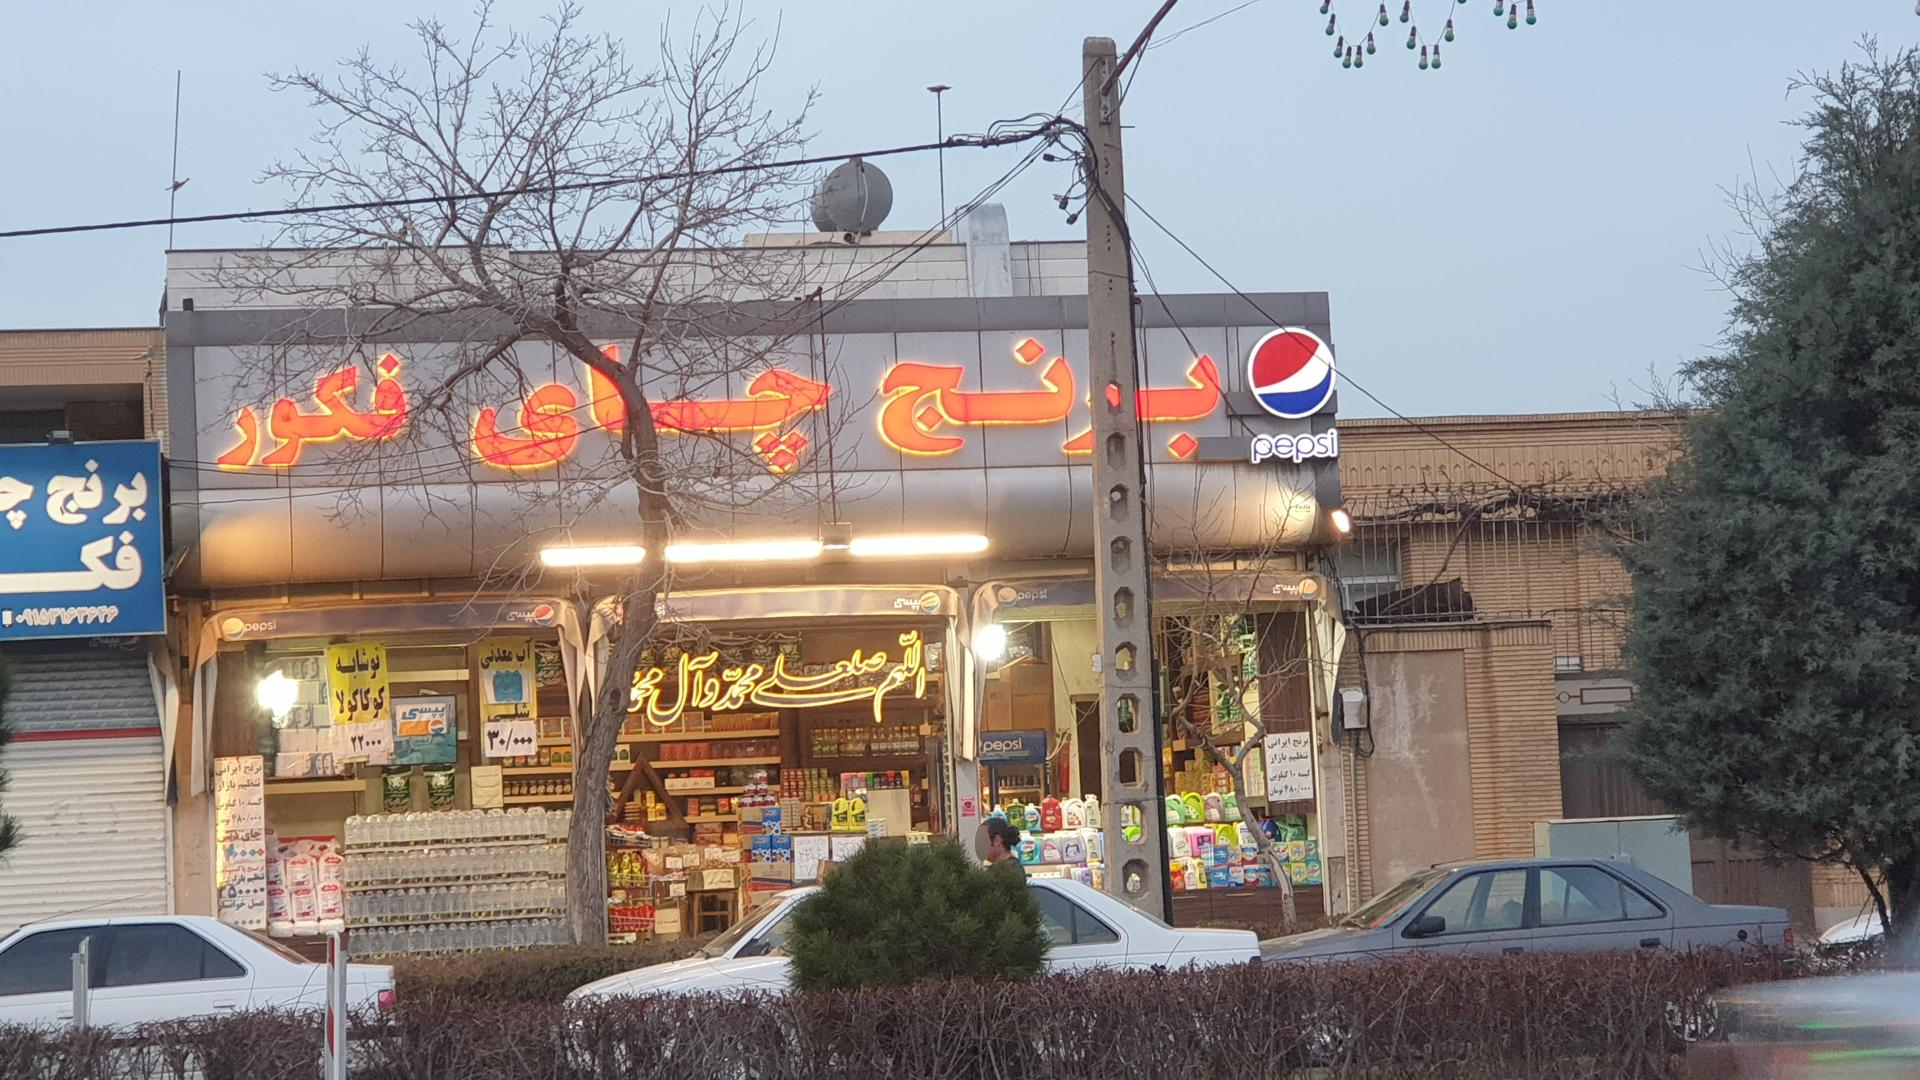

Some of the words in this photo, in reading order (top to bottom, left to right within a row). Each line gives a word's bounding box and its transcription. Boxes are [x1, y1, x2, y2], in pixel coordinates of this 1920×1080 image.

[216, 353, 408, 470] فکور
[473, 343, 832, 474] چای
[1250, 429, 1338, 463] pepsi
[46, 459, 147, 524] برنج
[0, 530, 142, 593] فک
[894, 597, 921, 610] پپسی
[1016, 588, 1048, 601] pepsi
[244, 619, 277, 633] pepsi
[506, 611, 535, 623] پپسی
[481, 643, 513, 669] معدنی
[516, 637, 533, 667] آب
[336, 647, 380, 679] نوشابه
[336, 686, 385, 721] کوکاکولا
[402, 706, 444, 719] پپسی
[350, 734, 382, 752] ۲۲۰۰۰
[487, 728, 533, 751] ۳۰/۰۰۰
[983, 738, 1022, 753] pepsi
[1267, 737, 1291, 749] ایرانی
[1293, 737, 1309, 748] برنج
[1270, 753, 1287, 764] بازار
[1288, 752, 1309, 763] تنظیم
